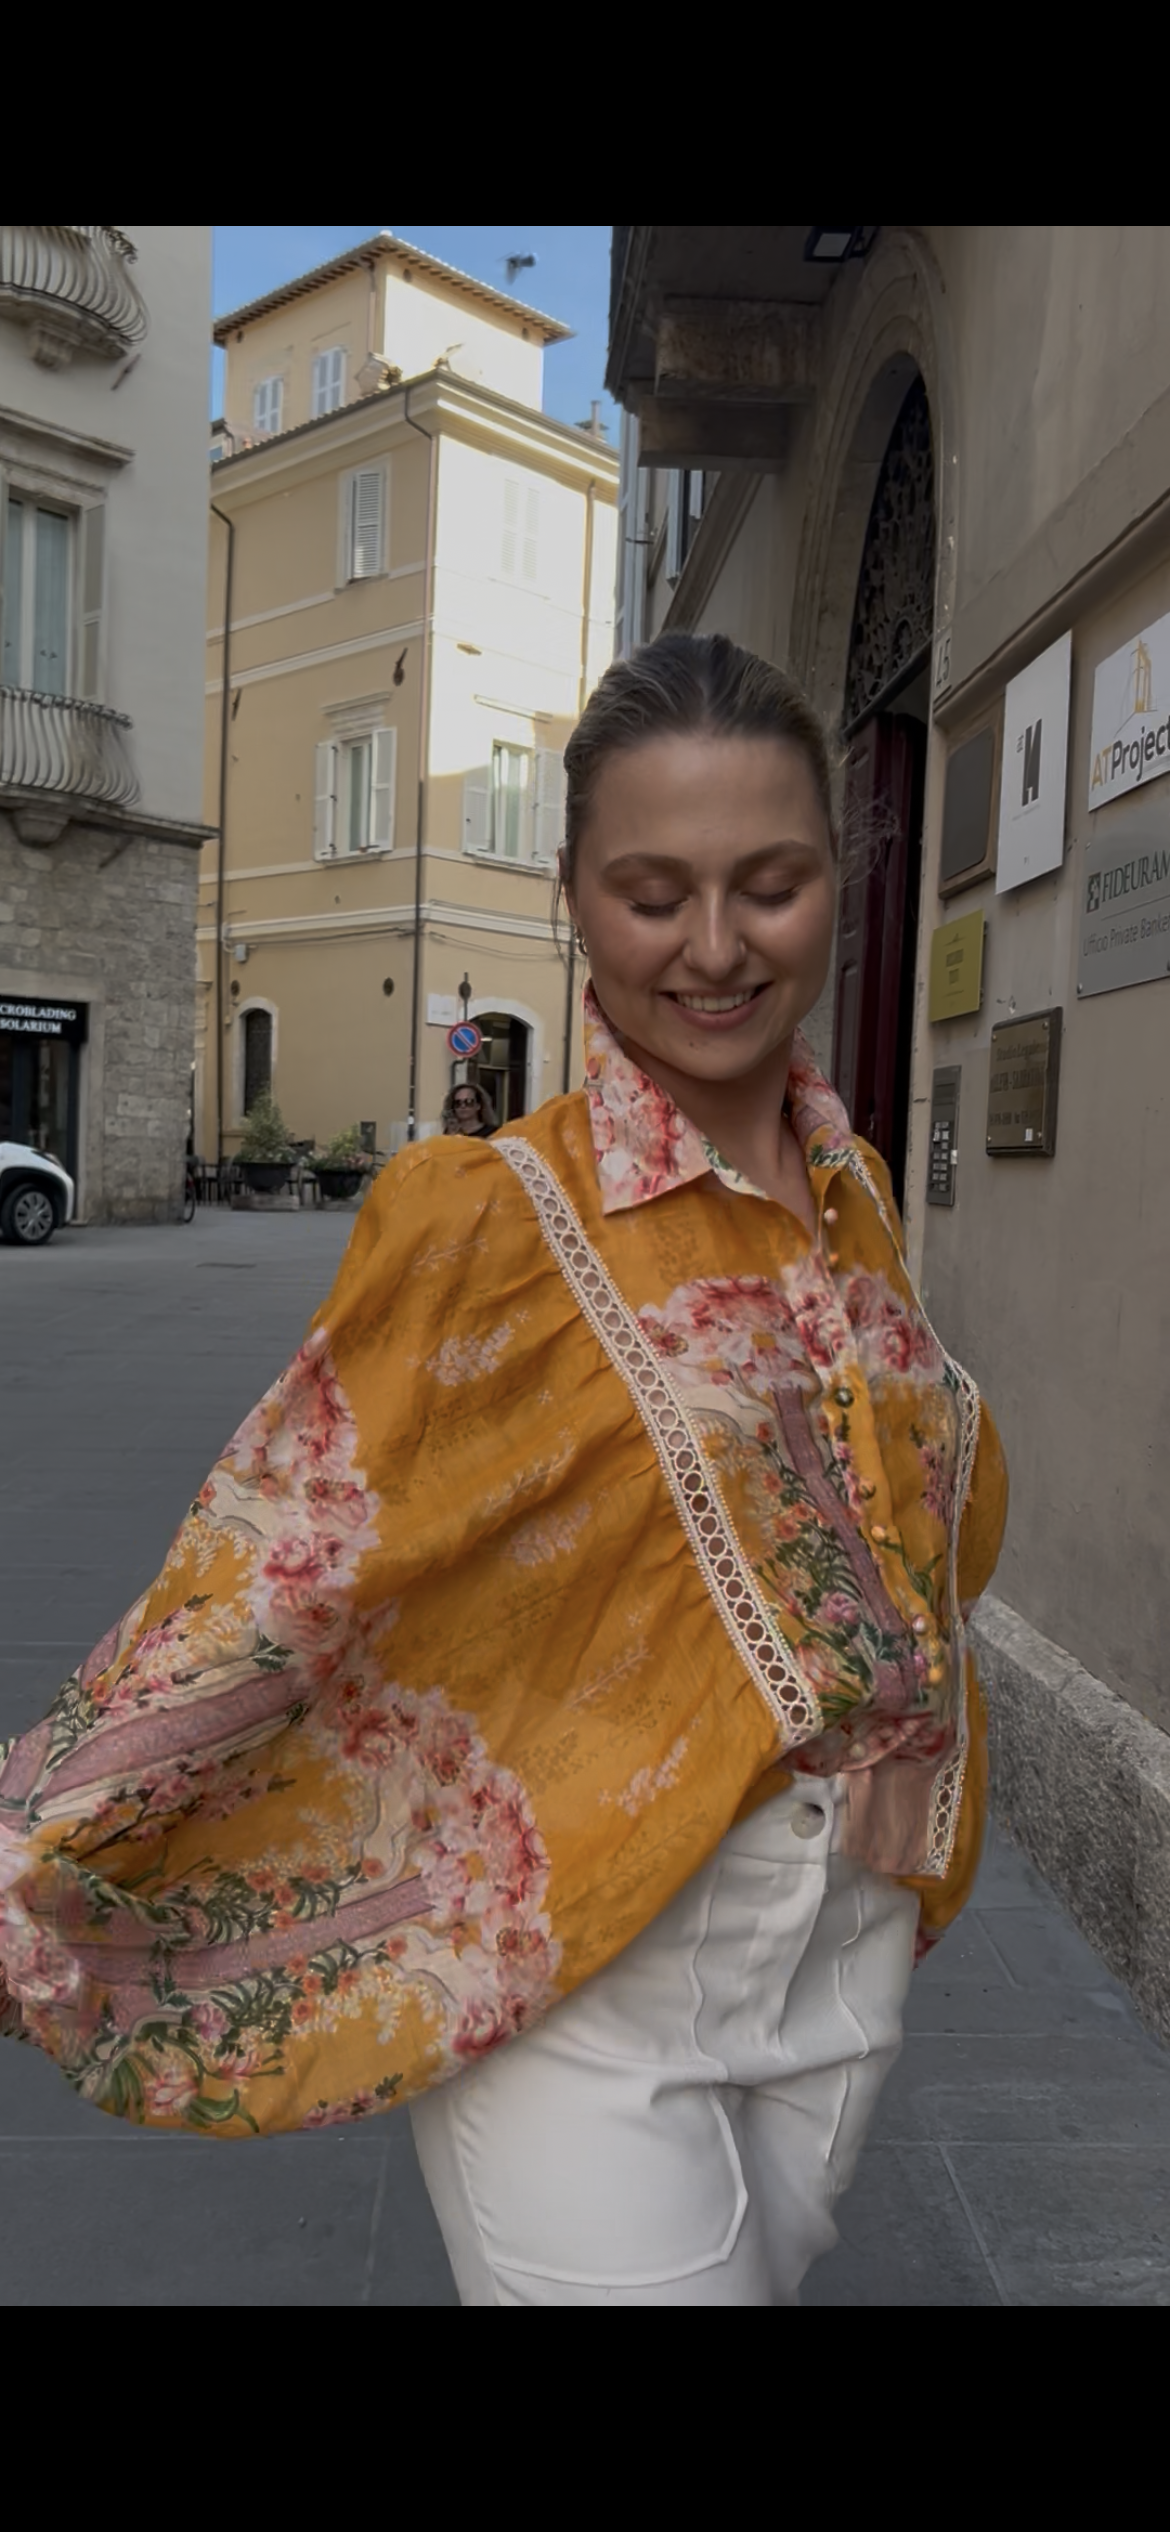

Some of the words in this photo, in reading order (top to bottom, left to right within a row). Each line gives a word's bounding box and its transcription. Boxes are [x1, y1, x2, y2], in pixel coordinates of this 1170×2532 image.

[1083, 932, 1108, 957] Ufficio
[1109, 924, 1138, 949] Private
[0, 1003, 77, 1021] CROBLADING
[0, 1018, 62, 1034] SOLARIUM
